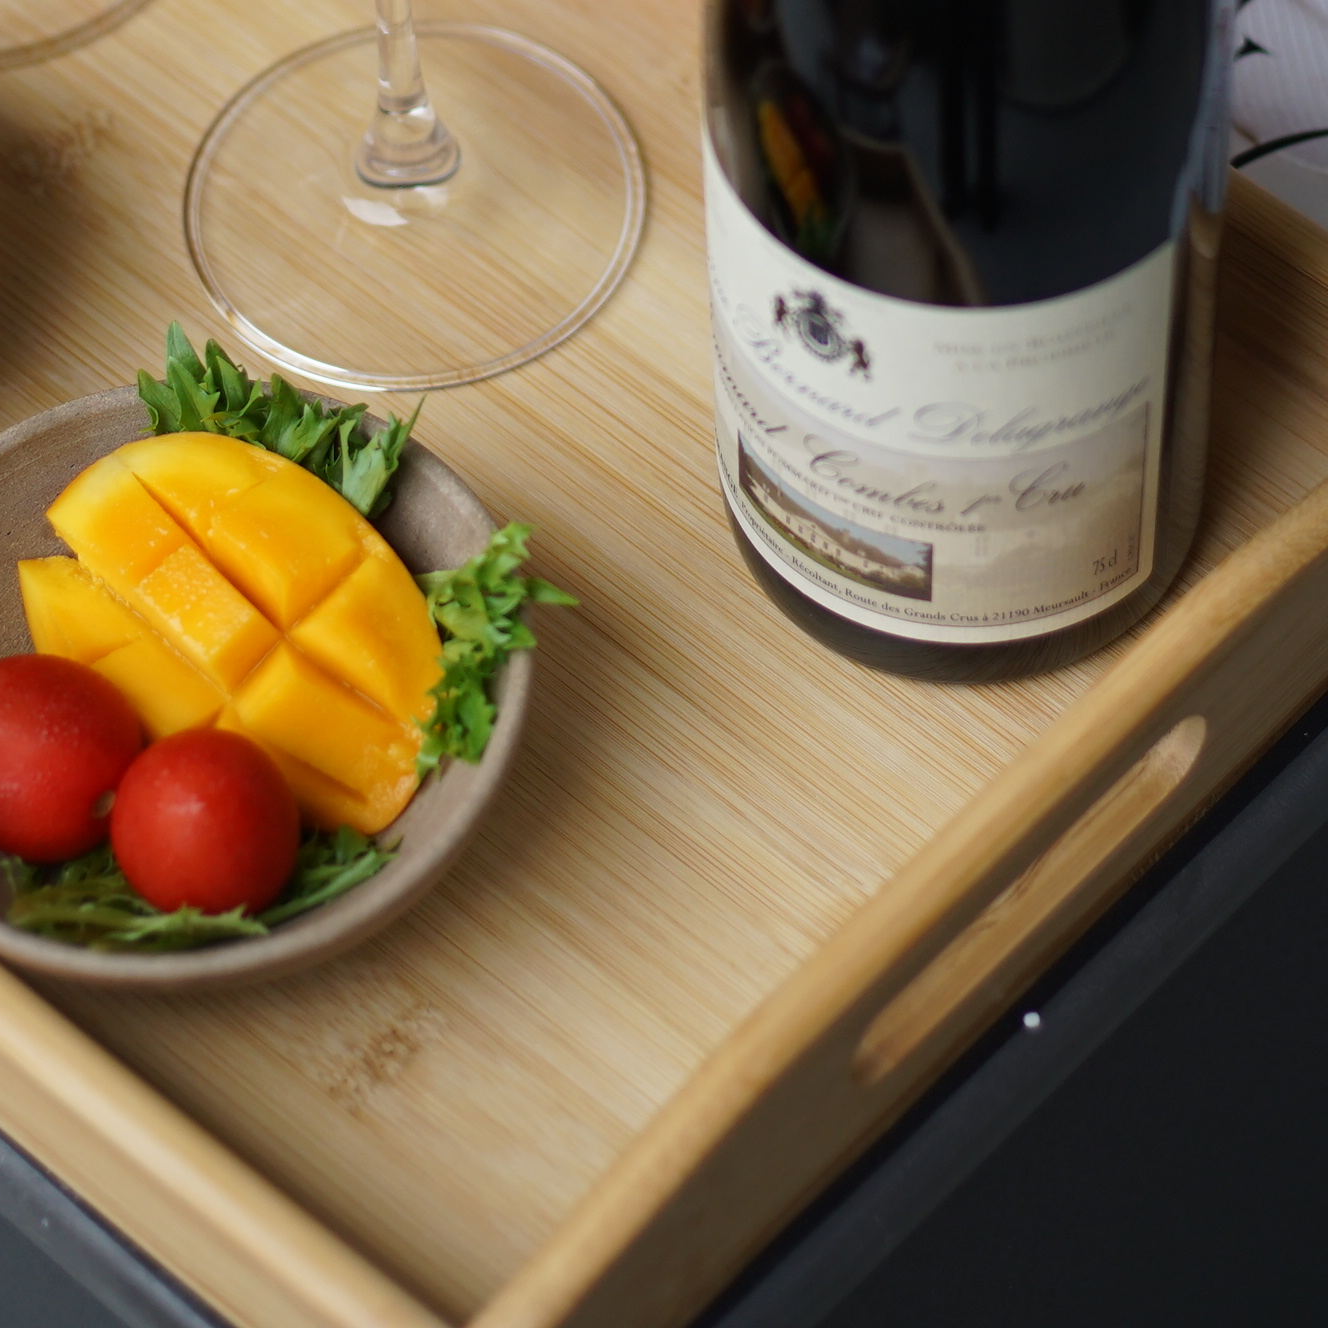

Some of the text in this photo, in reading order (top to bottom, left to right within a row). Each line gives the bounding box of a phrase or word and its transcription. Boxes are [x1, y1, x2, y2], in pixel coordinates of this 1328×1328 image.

[803, 433, 944, 515] Combes
[1008, 460, 1085, 512] Cru
[740, 500, 784, 554] Propriétaire
[791, 555, 843, 594] Récoltant,
[845, 587, 878, 608] Route
[881, 601, 900, 614] des
[903, 606, 946, 621] Grands
[950, 612, 979, 623] Crus
[982, 611, 989, 622] à
[992, 608, 1030, 622] 21190
[1033, 590, 1090, 614] Meursault
[1099, 567, 1131, 591] France
[1092, 548, 1117, 575] 75 cl
